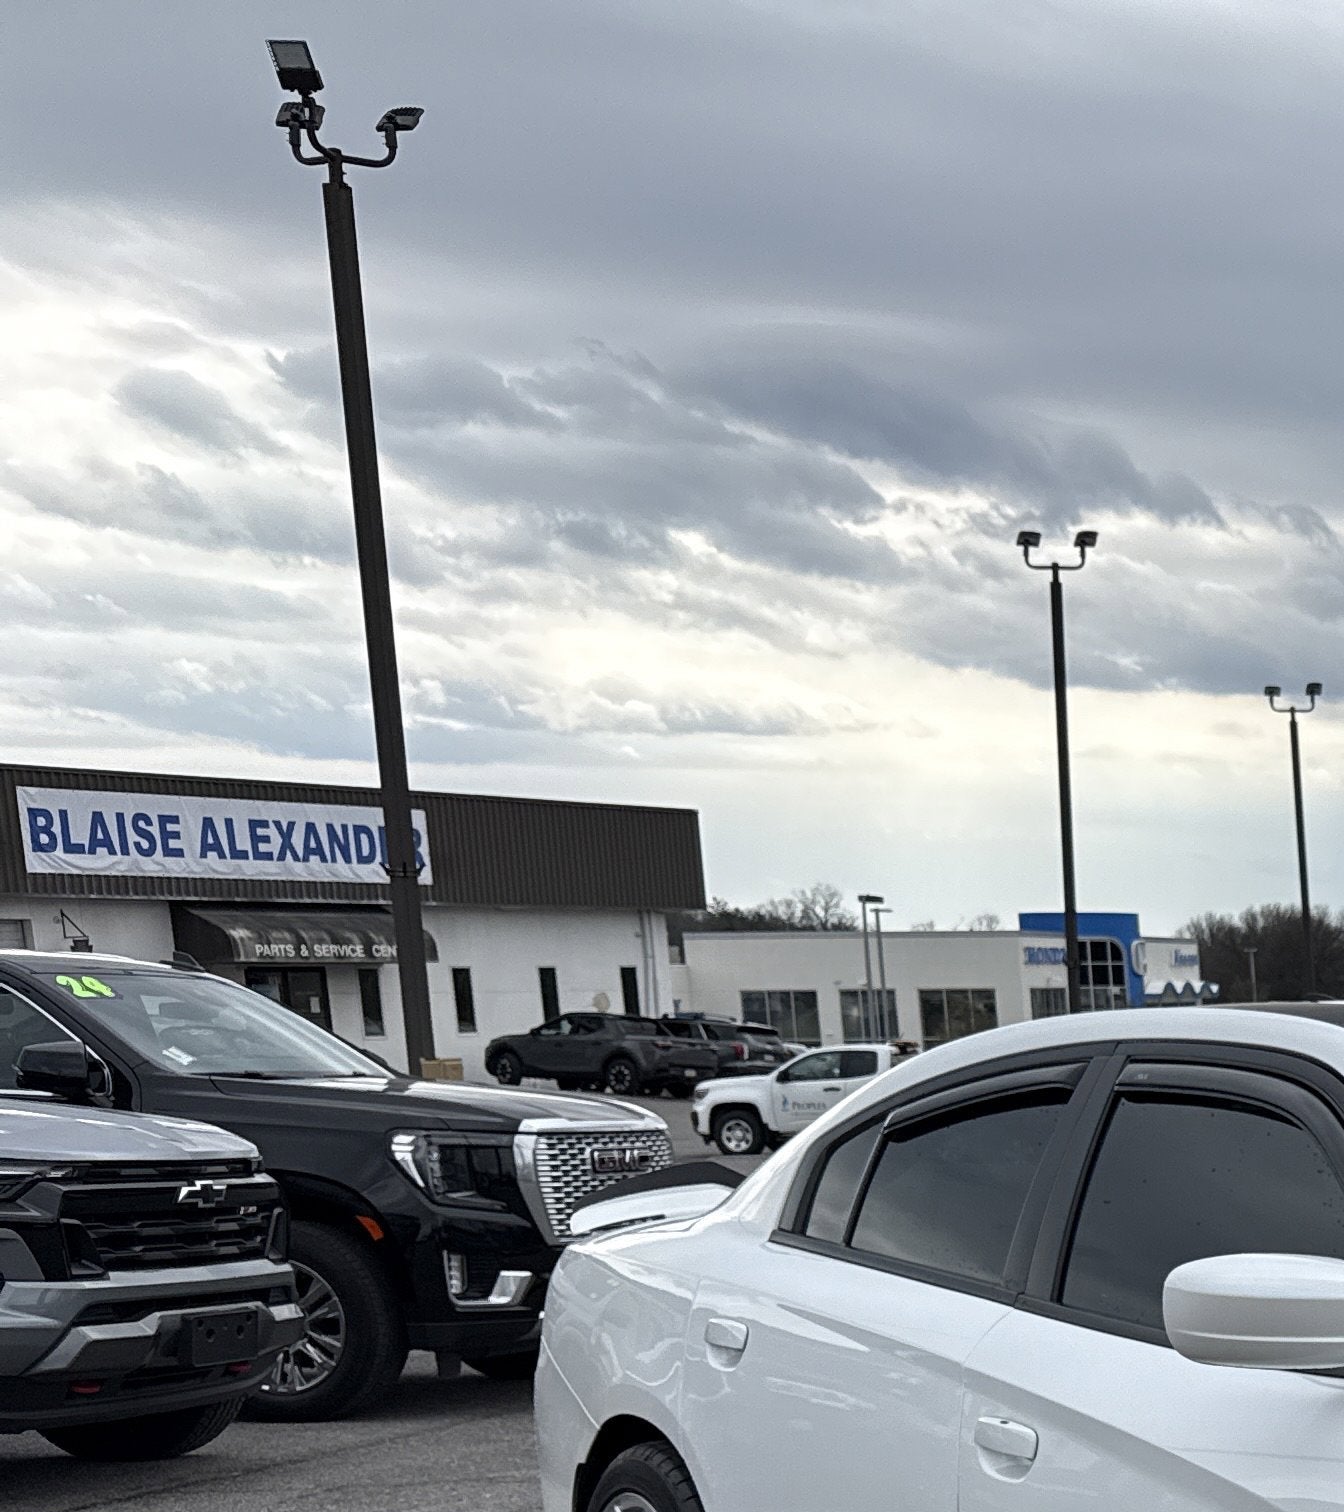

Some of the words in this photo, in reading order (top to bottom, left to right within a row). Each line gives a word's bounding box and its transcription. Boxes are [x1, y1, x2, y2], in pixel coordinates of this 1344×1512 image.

[26, 806, 185, 859] BLAISE
[255, 944, 295, 957] PARTS
[301, 945, 309, 957] &
[314, 944, 365, 958] SERVICE
[372, 945, 398, 958] CEN
